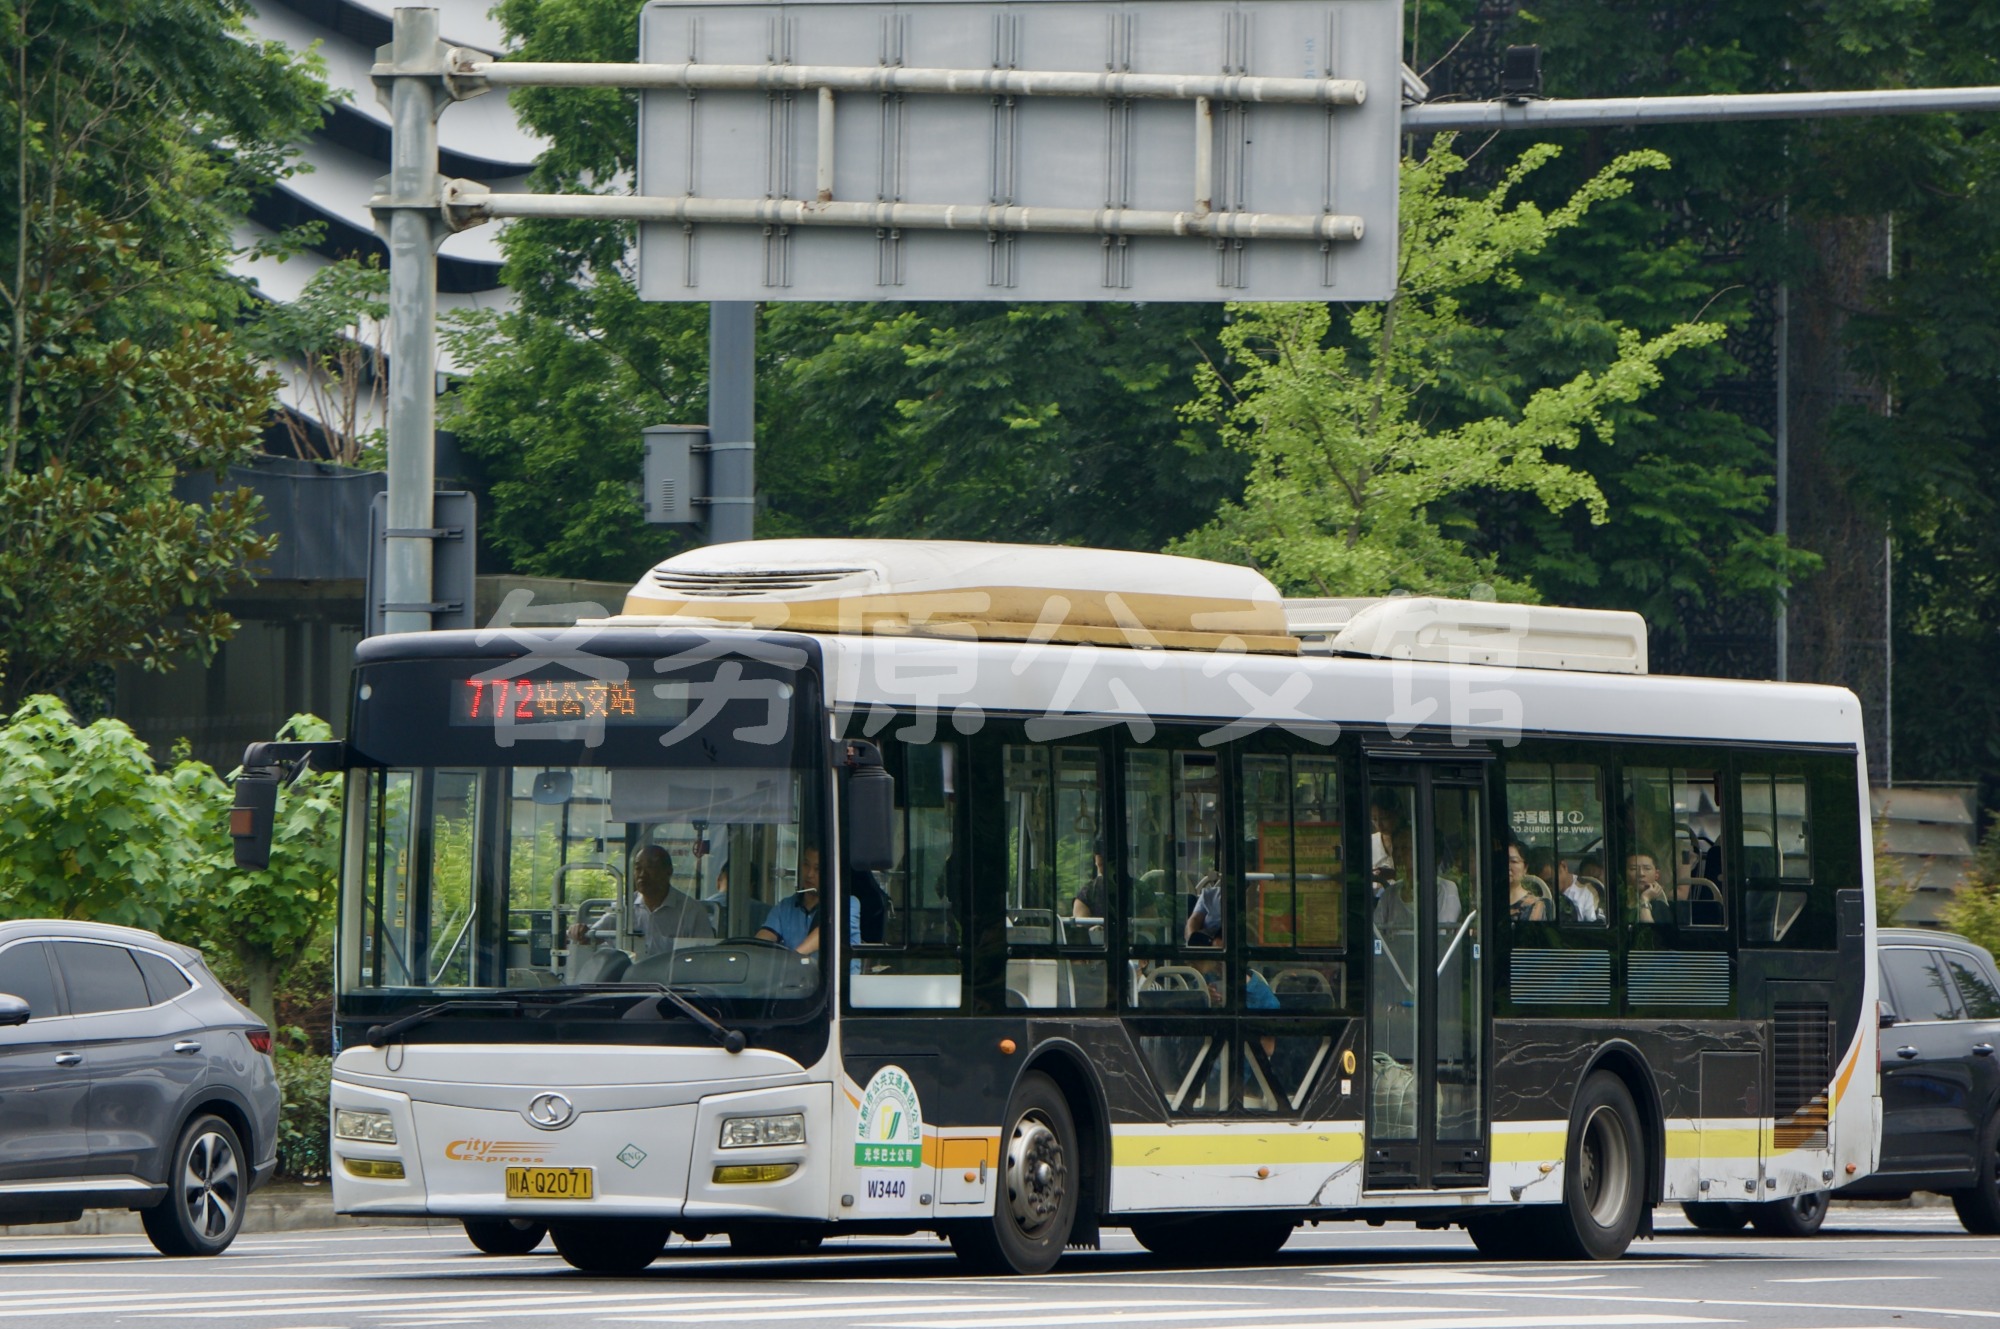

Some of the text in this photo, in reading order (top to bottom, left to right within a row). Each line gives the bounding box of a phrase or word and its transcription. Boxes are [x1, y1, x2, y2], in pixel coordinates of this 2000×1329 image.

[466, 679, 534, 718] 772
[537, 680, 636, 717] 站公交站
[445, 1138, 492, 1160] City
[621, 1152, 641, 1162] CNG
[864, 1148, 913, 1162] 光华巴士公司
[463, 1154, 544, 1163] Express
[868, 1180, 905, 1198] W3440
